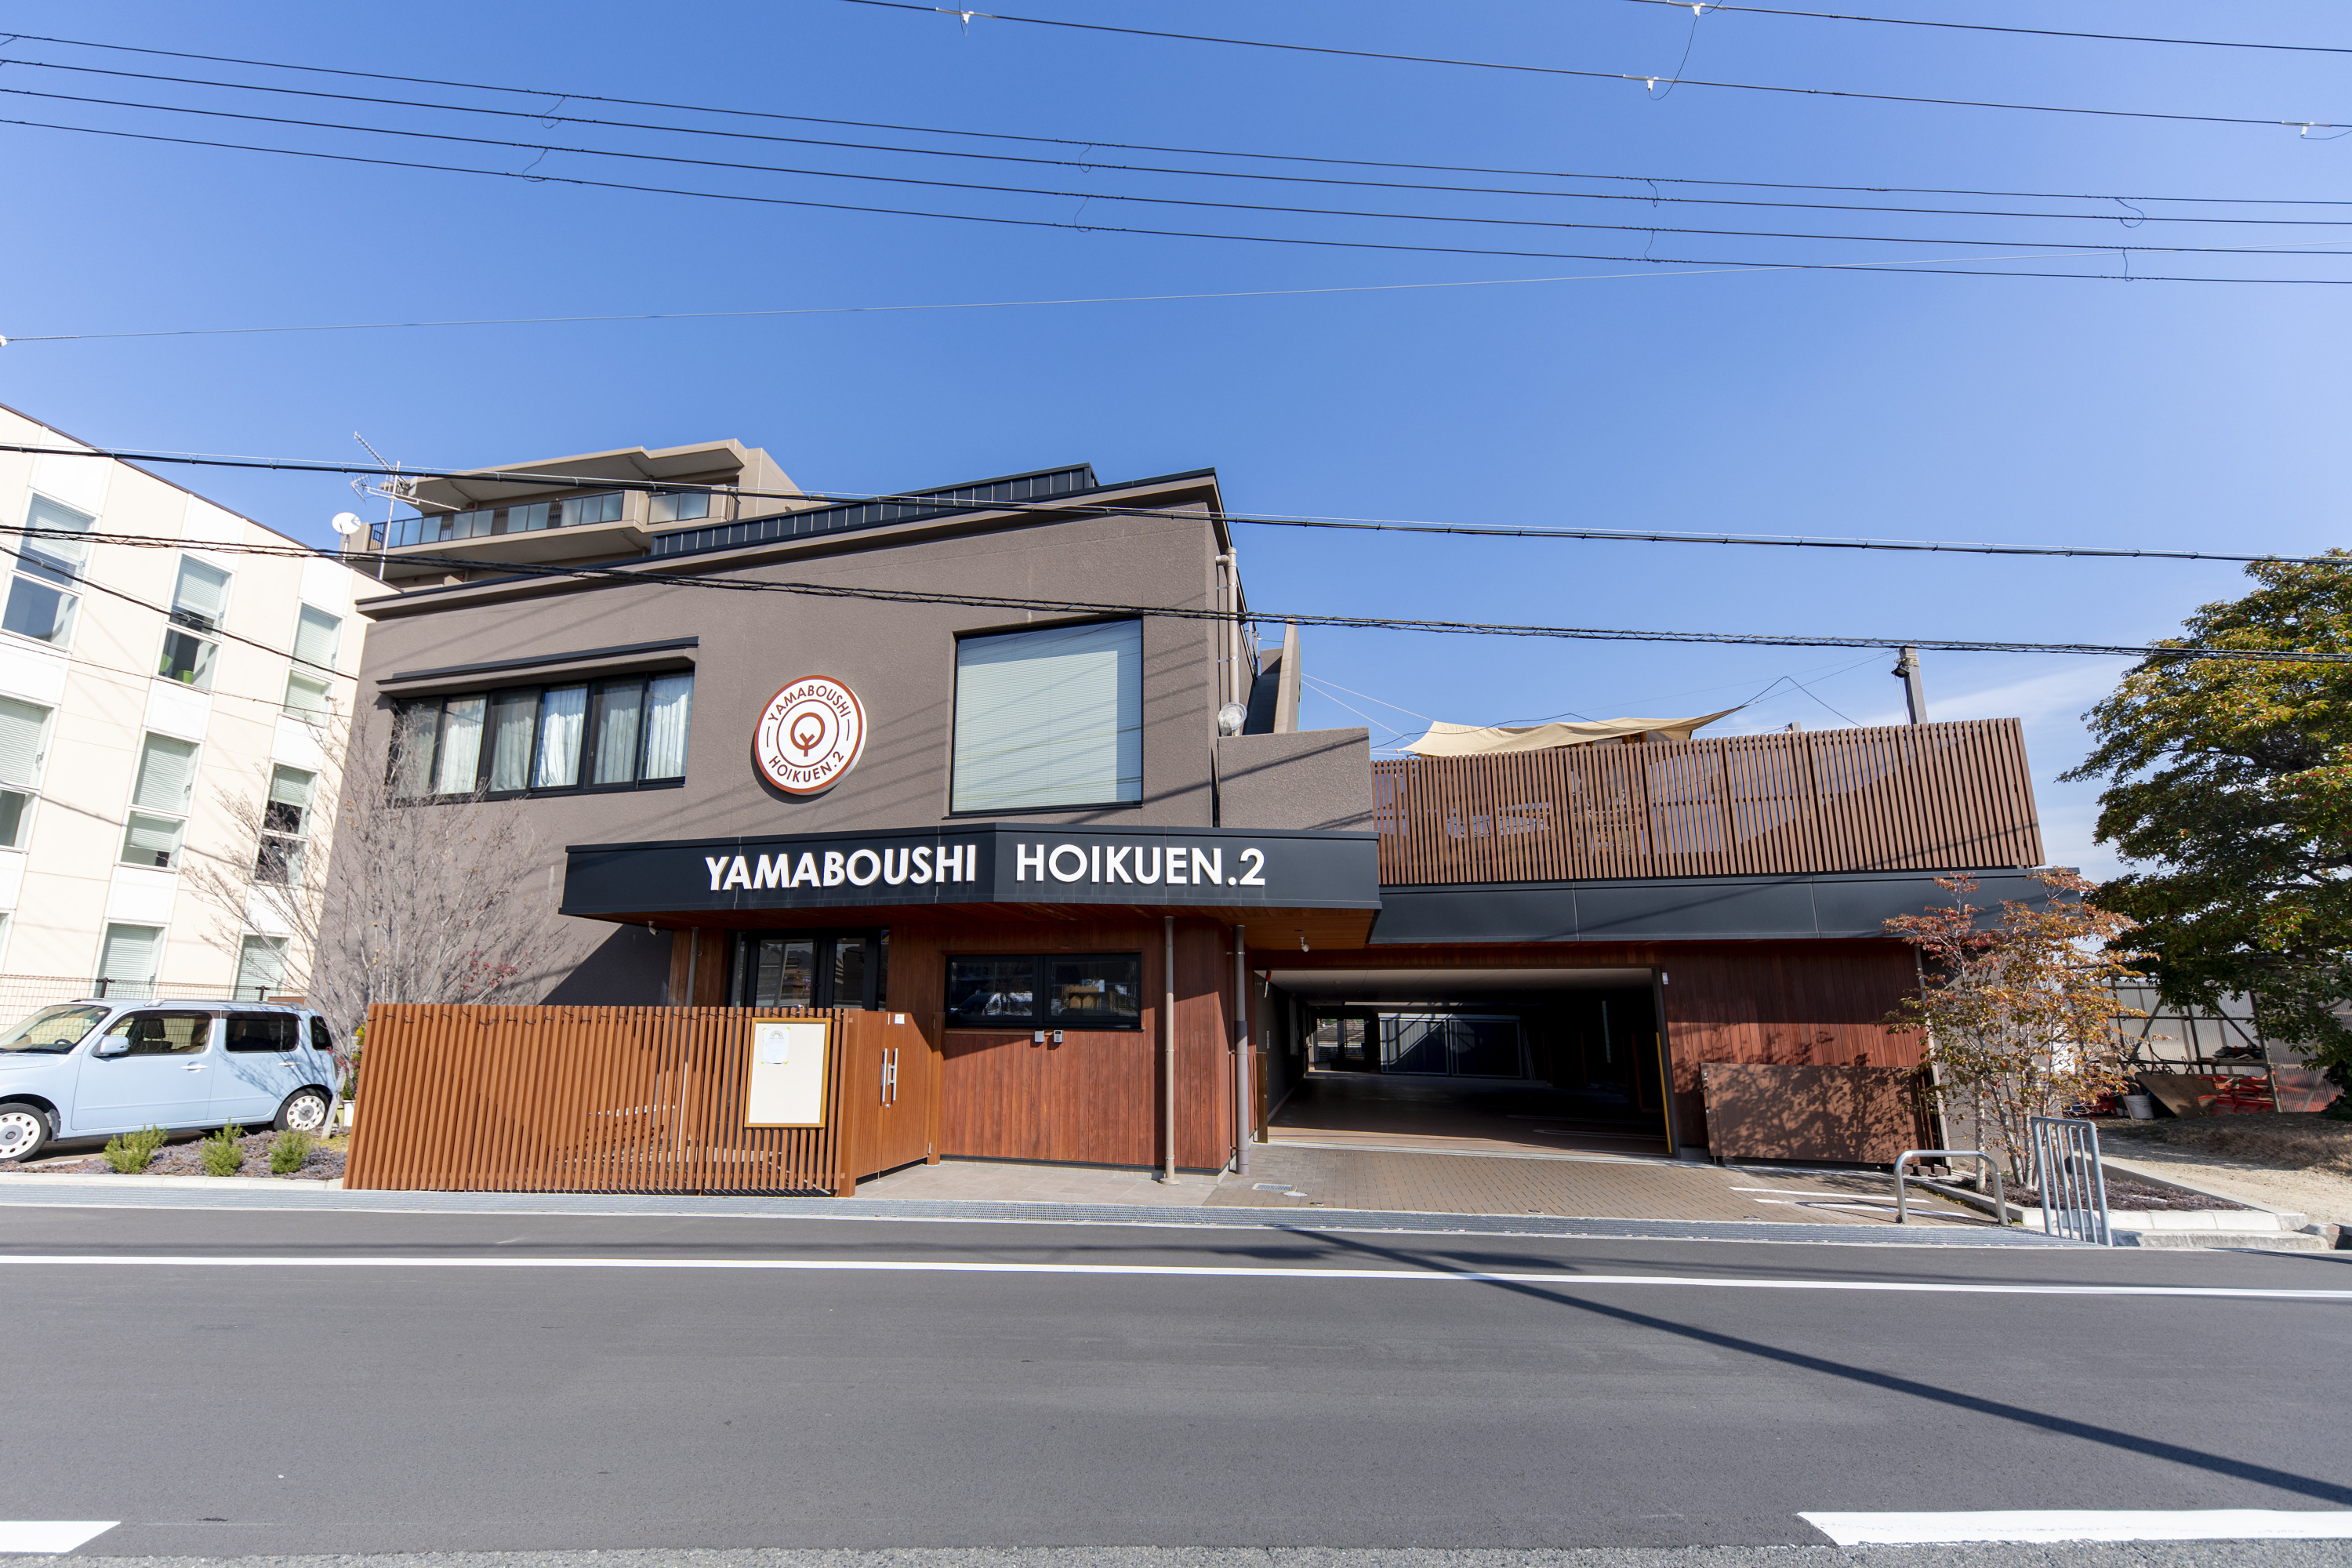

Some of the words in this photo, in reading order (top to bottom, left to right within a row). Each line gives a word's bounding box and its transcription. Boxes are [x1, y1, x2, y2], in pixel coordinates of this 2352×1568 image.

[768, 684, 851, 721] YAMABOUSHI
[768, 750, 844, 782] HOIKUEN.2
[705, 844, 976, 891] YAMABOUSHI
[1015, 844, 1265, 886] HOIKUEN.2
